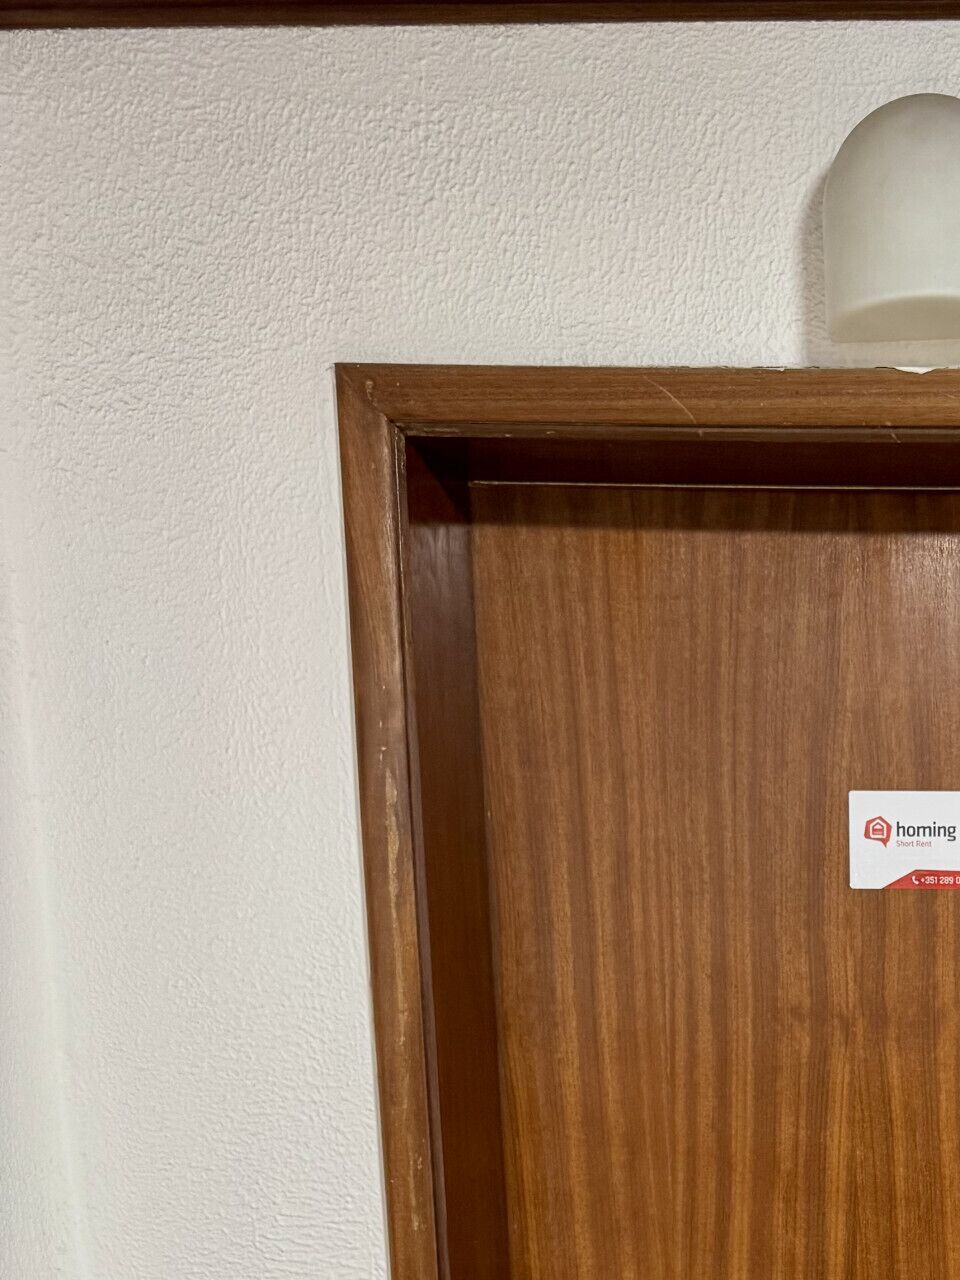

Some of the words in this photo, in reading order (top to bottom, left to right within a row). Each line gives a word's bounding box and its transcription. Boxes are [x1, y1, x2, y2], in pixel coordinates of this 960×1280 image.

[896, 821, 957, 842] homing
[896, 840, 914, 848] Short
[915, 840, 932, 848] Rent
[920, 876, 938, 885] +351
[939, 876, 954, 885] 289
